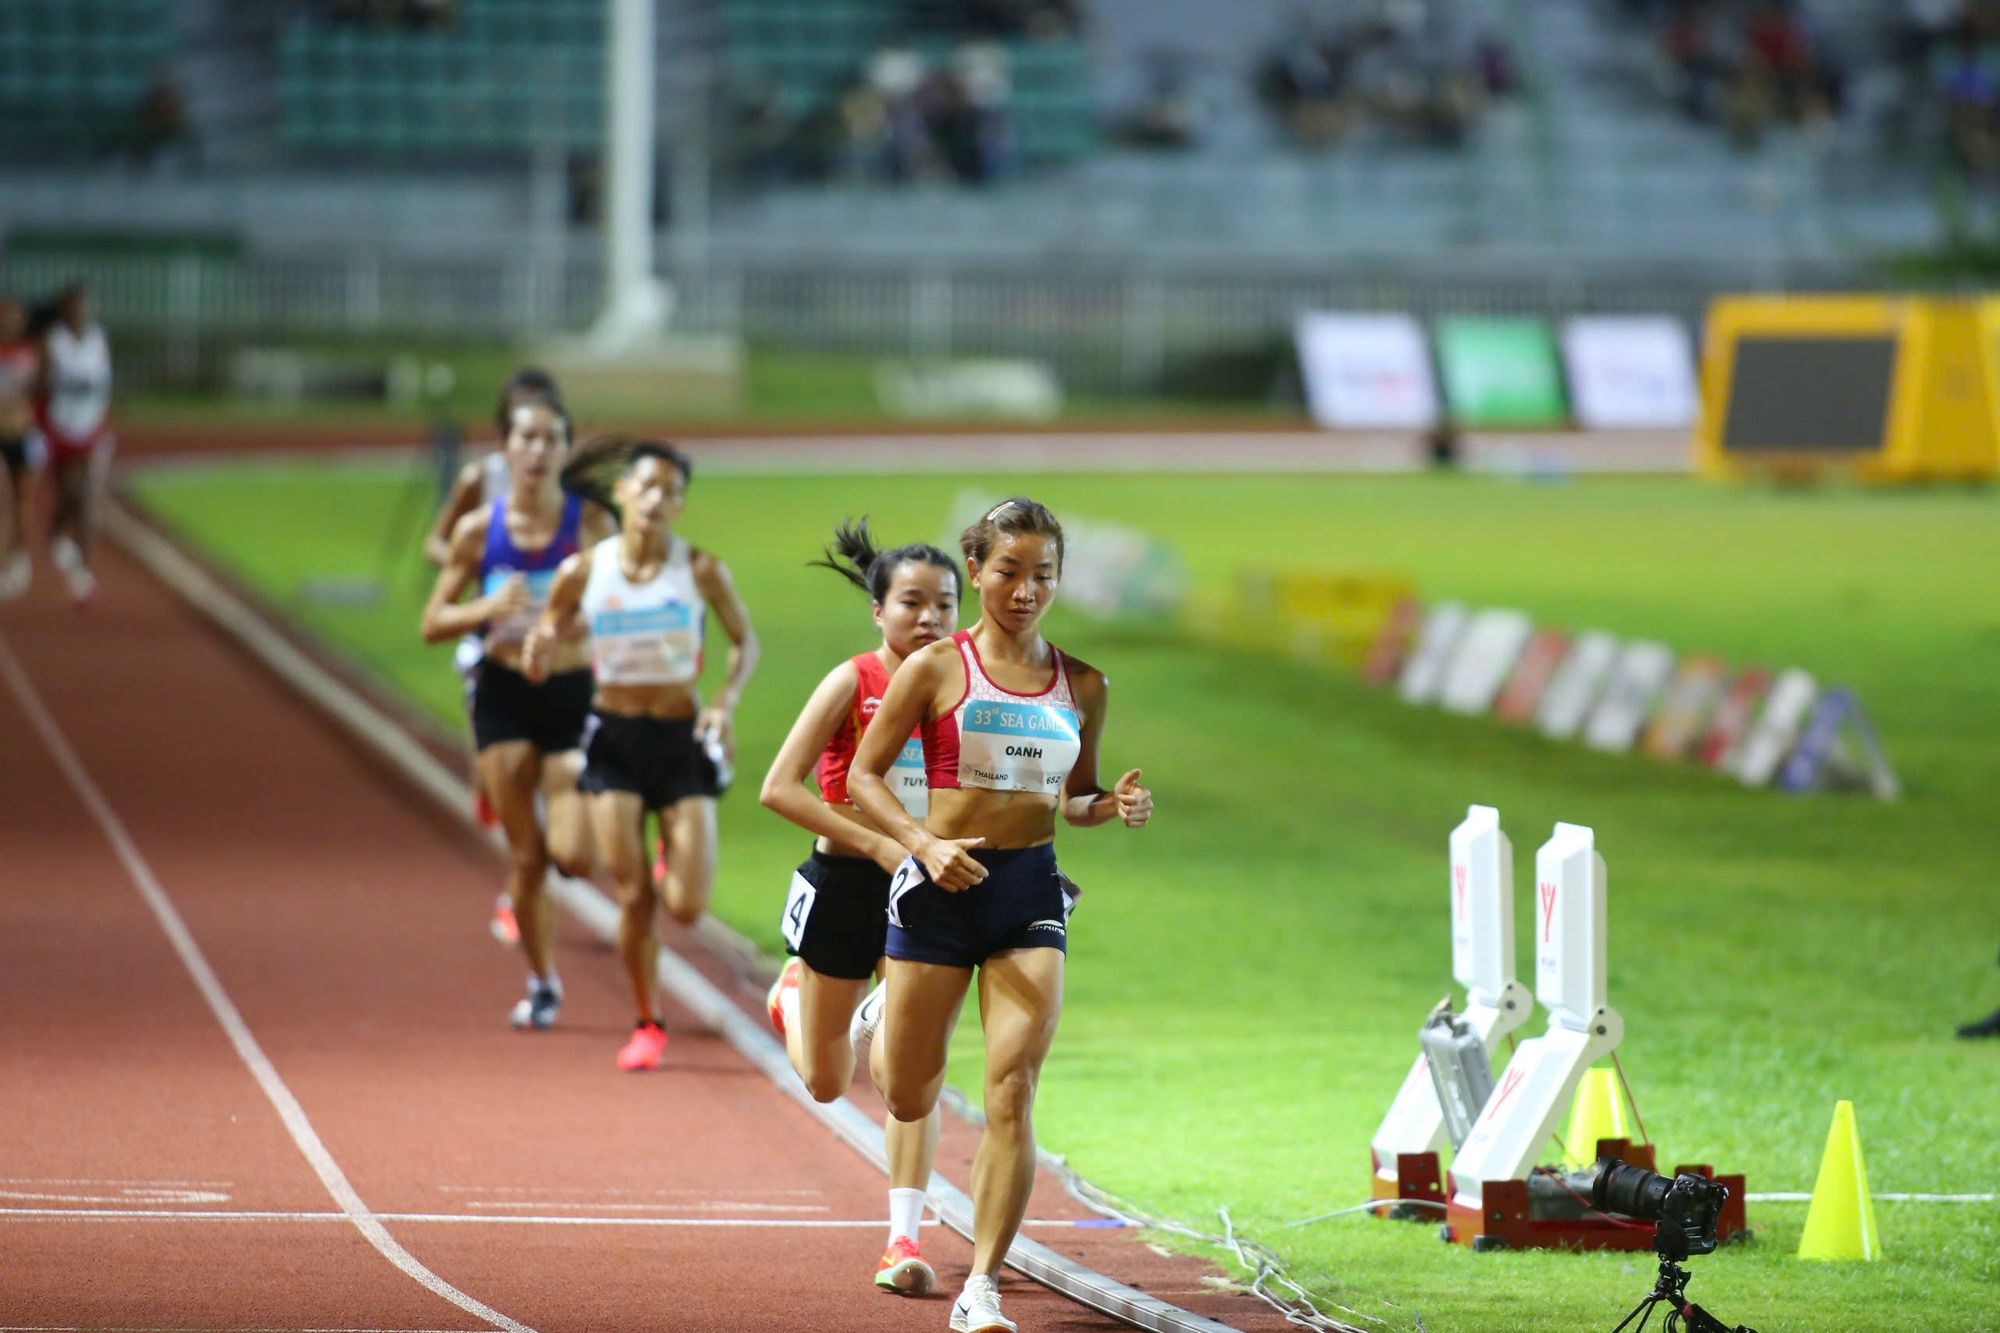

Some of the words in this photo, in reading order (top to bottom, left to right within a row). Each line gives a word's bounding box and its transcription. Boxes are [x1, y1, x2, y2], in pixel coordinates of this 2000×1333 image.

[1000, 712, 1024, 729] SEA
[1028, 714, 1067, 732] GAME
[1005, 745, 1043, 759] OANH
[903, 776, 928, 787] TUY
[974, 769, 1009, 781] THAILAND
[891, 867, 909, 918] 2
[789, 891, 807, 937] 4
